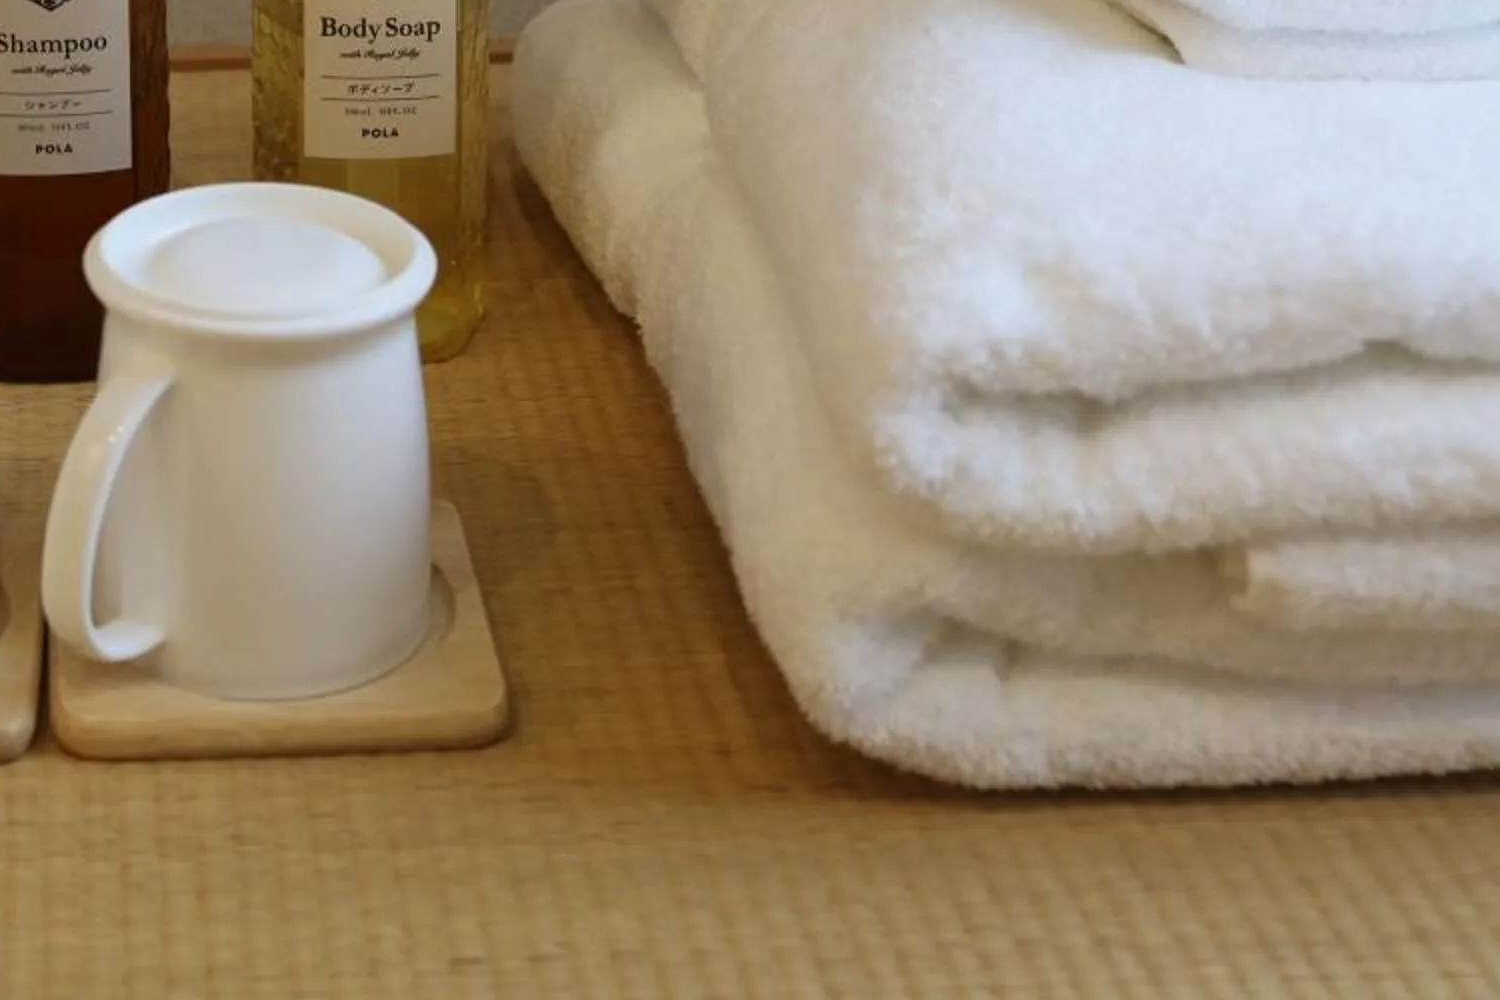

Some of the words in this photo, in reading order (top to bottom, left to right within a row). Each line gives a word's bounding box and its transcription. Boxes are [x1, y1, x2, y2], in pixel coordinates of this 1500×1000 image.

[320, 17, 382, 45] Body
[385, 17, 441, 42] Soap
[361, 128, 399, 139] POLA
[35, 143, 73, 155] POLA
